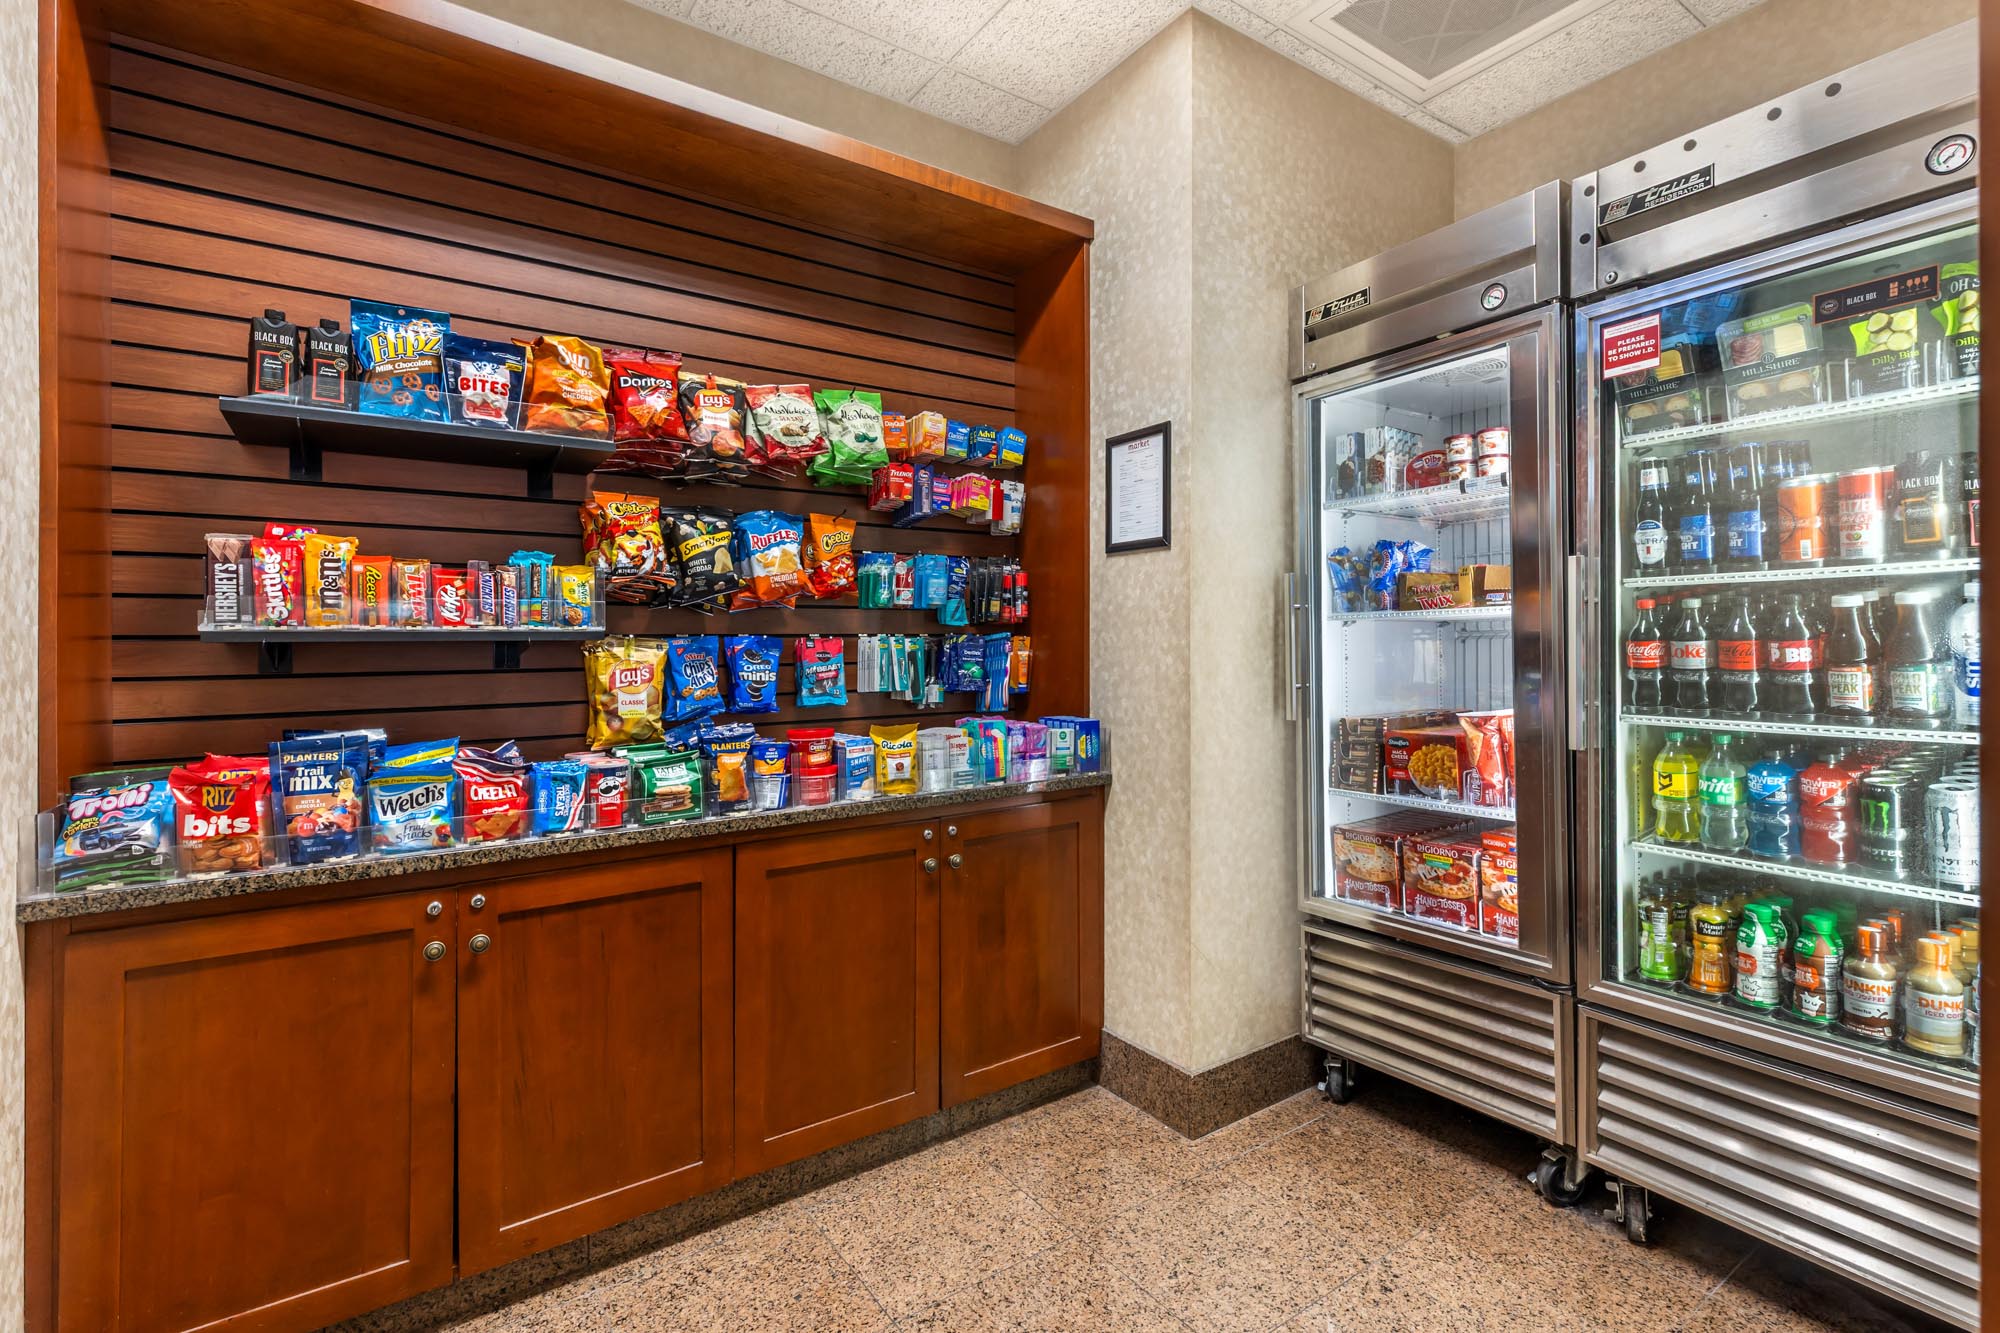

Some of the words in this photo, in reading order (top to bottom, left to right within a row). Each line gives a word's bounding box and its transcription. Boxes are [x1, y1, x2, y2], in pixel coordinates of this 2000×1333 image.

[1950, 278, 1968, 294] OH
[1846, 294, 1864, 305] BLACK
[1865, 291, 1877, 301] BOX
[254, 331, 277, 345] BLACK
[279, 333, 294, 347] BOX
[1617, 335, 1645, 347] PLEASE
[1618, 339, 1656, 353] PREPARED
[310, 340, 333, 353] BLACK
[335, 342, 348, 355] BOX
[367, 331, 444, 363] Flipz
[557, 345, 590, 369] Sun
[1608, 355, 1618, 363] TO
[1619, 349, 1642, 360] SHOW
[1642, 347, 1656, 355] I.D.
[1871, 355, 1897, 367] Dilly
[376, 364, 393, 373] Milk
[393, 359, 432, 372] Chocolate
[1741, 357, 1801, 377] HILLSHIRE
[459, 377, 511, 398] BITES
[620, 376, 673, 390] Doritos
[1630, 381, 1679, 399] HILLSHIRE
[699, 393, 731, 408] Lay's
[763, 406, 784, 415] Miss
[840, 409, 857, 422] Miss
[978, 430, 996, 439] Advil
[1128, 439, 1150, 451] market
[1424, 453, 1442, 465] Dibs
[890, 469, 913, 478] TYLENOL
[1924, 475, 1940, 486] BOX
[684, 534, 731, 557] Smartfood
[751, 529, 800, 550] RUFFLES
[687, 565, 712, 576] CHEDDAR
[688, 559, 707, 568] WHITE
[261, 547, 289, 620] Skittles
[770, 573, 798, 584] CHEDDAR
[214, 562, 238, 620] HERSHEY'S
[405, 570, 427, 621] TWIX
[481, 573, 495, 613] SNICKERS
[1415, 594, 1456, 611] TWIX
[541, 600, 549, 621] KIND
[1627, 643, 1666, 657] Coca-Cola
[683, 660, 712, 679] Chips
[744, 662, 772, 671] OREO
[615, 667, 650, 687] Lay's
[739, 671, 777, 682] minis
[1831, 684, 1858, 694] PEAK
[1893, 684, 1921, 694] PEAK
[711, 742, 751, 752] PLANTERS
[881, 740, 913, 751] Ricola
[283, 752, 339, 764] PLANTERS
[296, 766, 324, 777] Trail
[656, 763, 684, 774] TATE'S
[289, 775, 334, 792] mix
[1699, 778, 1733, 794] prite
[202, 786, 237, 807] RITZ
[469, 783, 518, 801] CHEEZ-IT
[69, 783, 154, 821] Trolli
[379, 785, 446, 817] Welch's
[555, 785, 565, 817] TREATS
[183, 814, 251, 837] bits
[403, 823, 425, 833] Fruit
[396, 829, 433, 844] Snacks
[1345, 831, 1383, 846] DIGIORNO
[1416, 843, 1459, 859] DIGIORNO
[1414, 894, 1468, 914] HAND-TOSSED
[1702, 928, 1723, 936] Maid
[1925, 1010, 1945, 1018] ICED
